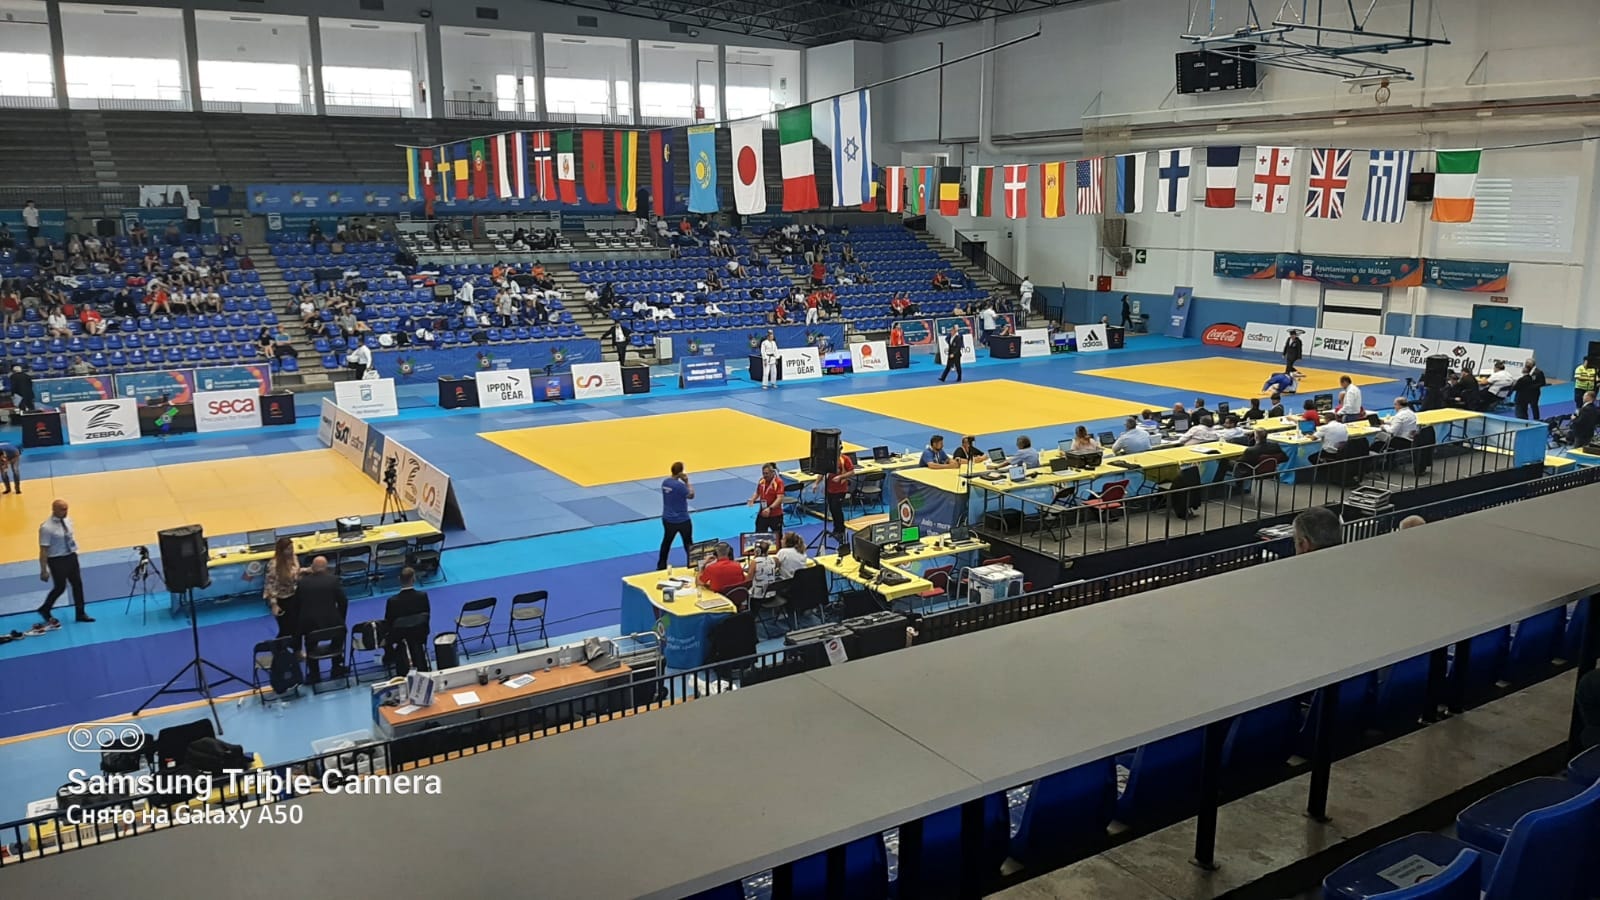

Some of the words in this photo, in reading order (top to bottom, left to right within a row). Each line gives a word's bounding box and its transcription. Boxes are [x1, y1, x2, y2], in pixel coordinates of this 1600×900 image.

[1315, 264, 1357, 274] Ayuntamiento
[1368, 266, 1391, 275] Málaga
[1206, 328, 1239, 342] Coca-Cola
[1247, 332, 1273, 342] essimo
[1081, 340, 1104, 348] adidas
[1323, 337, 1350, 346] GREEN
[1323, 344, 1345, 352] HILL
[1400, 347, 1421, 357] IPPON
[786, 359, 806, 368] IPPON
[797, 365, 815, 375] GEAR
[486, 383, 512, 393] IPPON
[501, 390, 524, 401] GEAR
[208, 398, 255, 415] seca
[85, 430, 125, 440] ZEBRA
